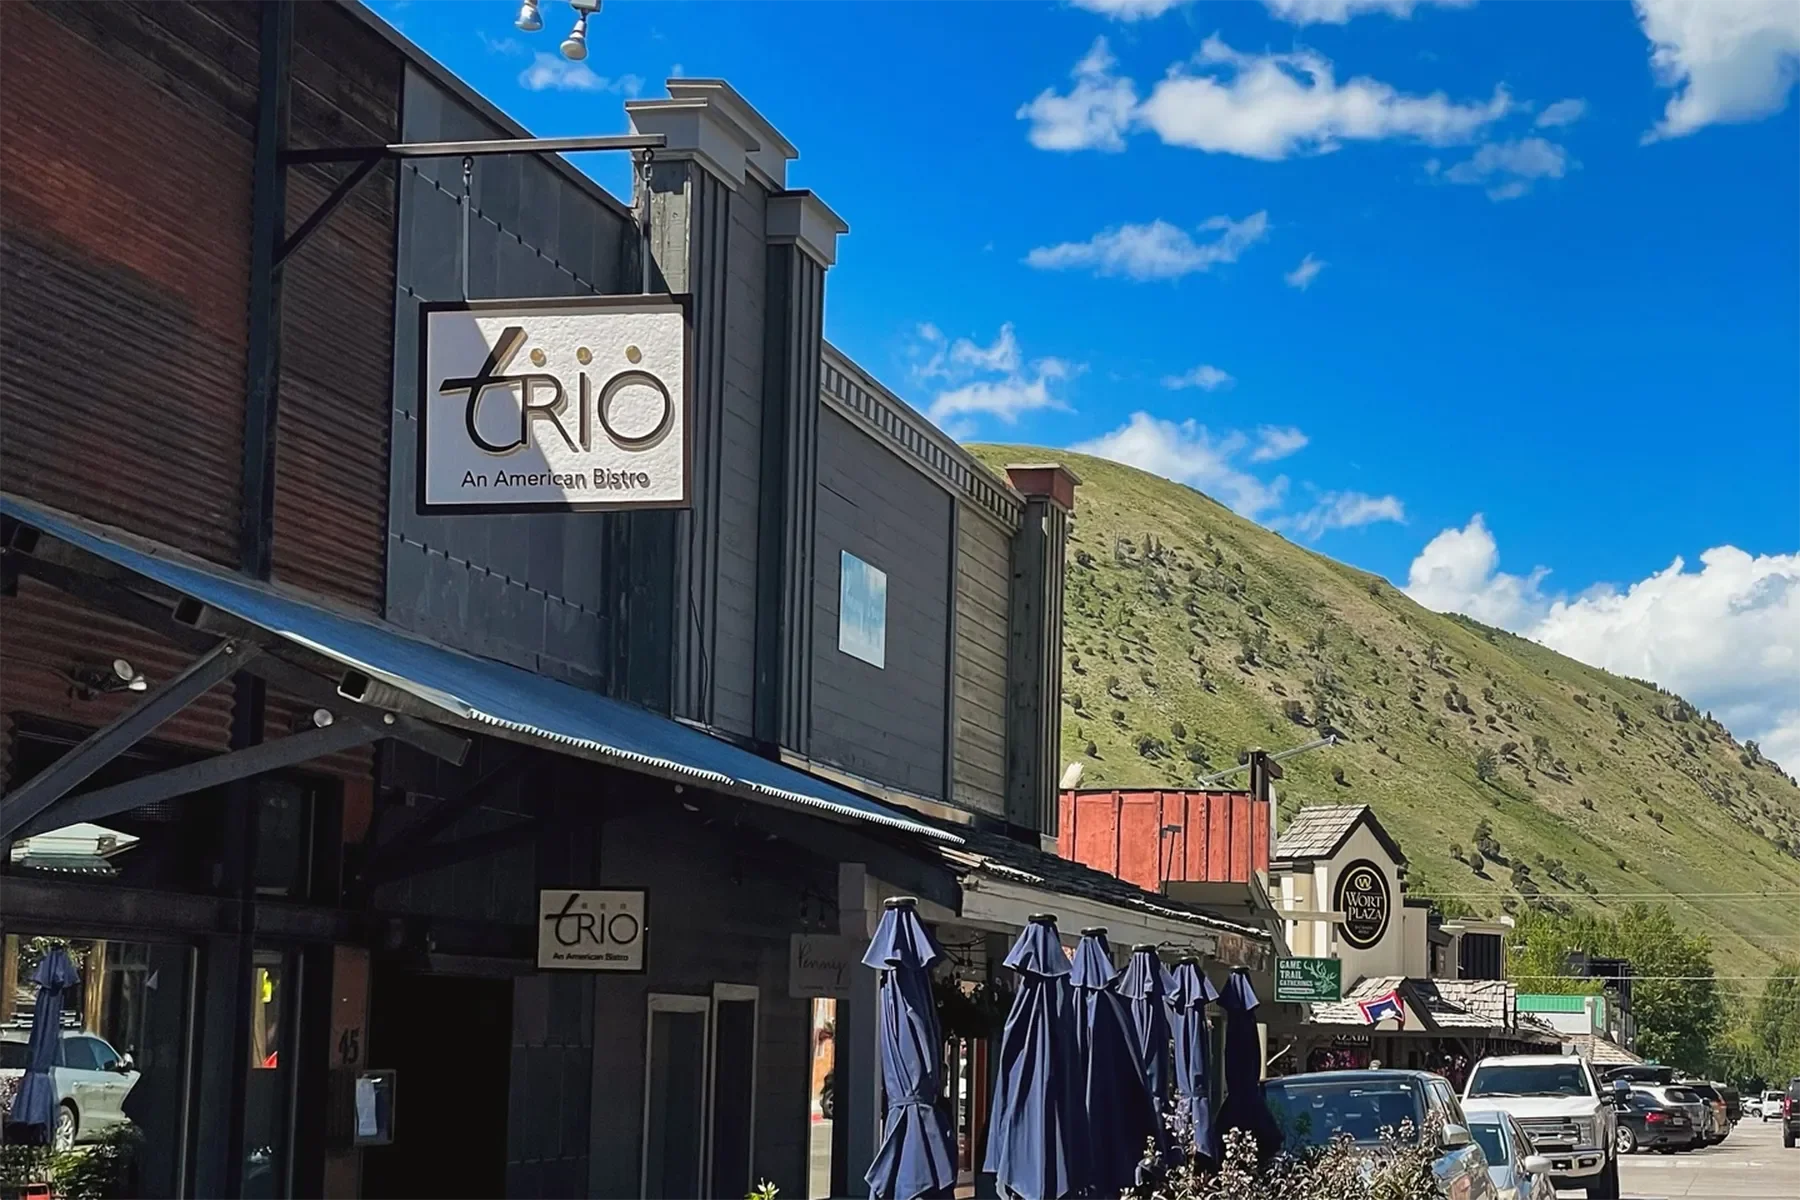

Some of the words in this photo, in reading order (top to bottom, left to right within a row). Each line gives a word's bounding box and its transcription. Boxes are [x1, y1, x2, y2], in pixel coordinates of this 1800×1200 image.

[461, 470, 487, 488] An
[494, 470, 586, 488] American
[593, 468, 650, 488] Bistro
[1346, 891, 1383, 907] WORT
[1348, 906, 1382, 921] PLAZA
[1280, 961, 1302, 970] GAME
[1280, 970, 1303, 980] TRAIL
